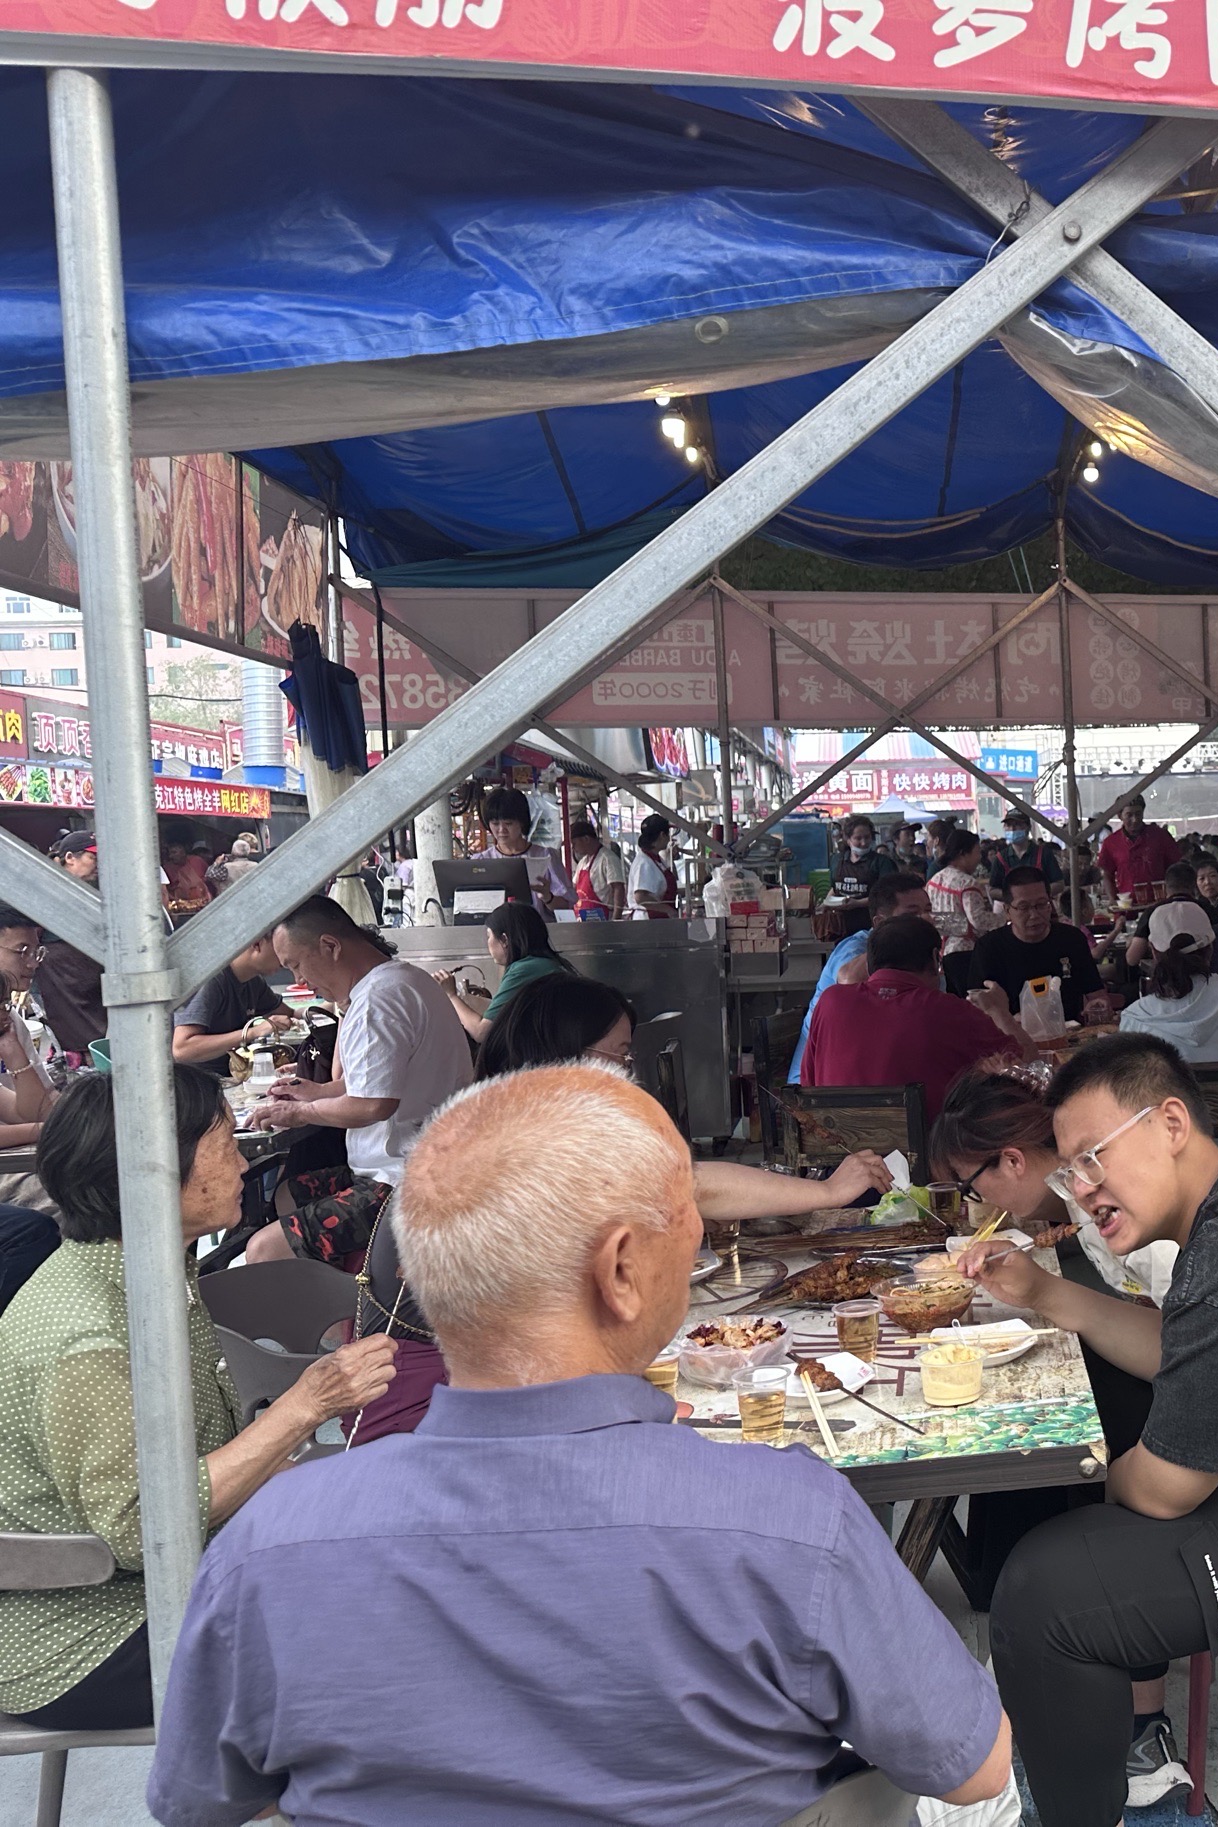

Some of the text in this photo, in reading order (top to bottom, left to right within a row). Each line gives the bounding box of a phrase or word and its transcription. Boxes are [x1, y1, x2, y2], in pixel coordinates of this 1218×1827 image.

[998, 755, 1034, 773] 进口通道
[893, 772, 967, 792] 快快烤肉
